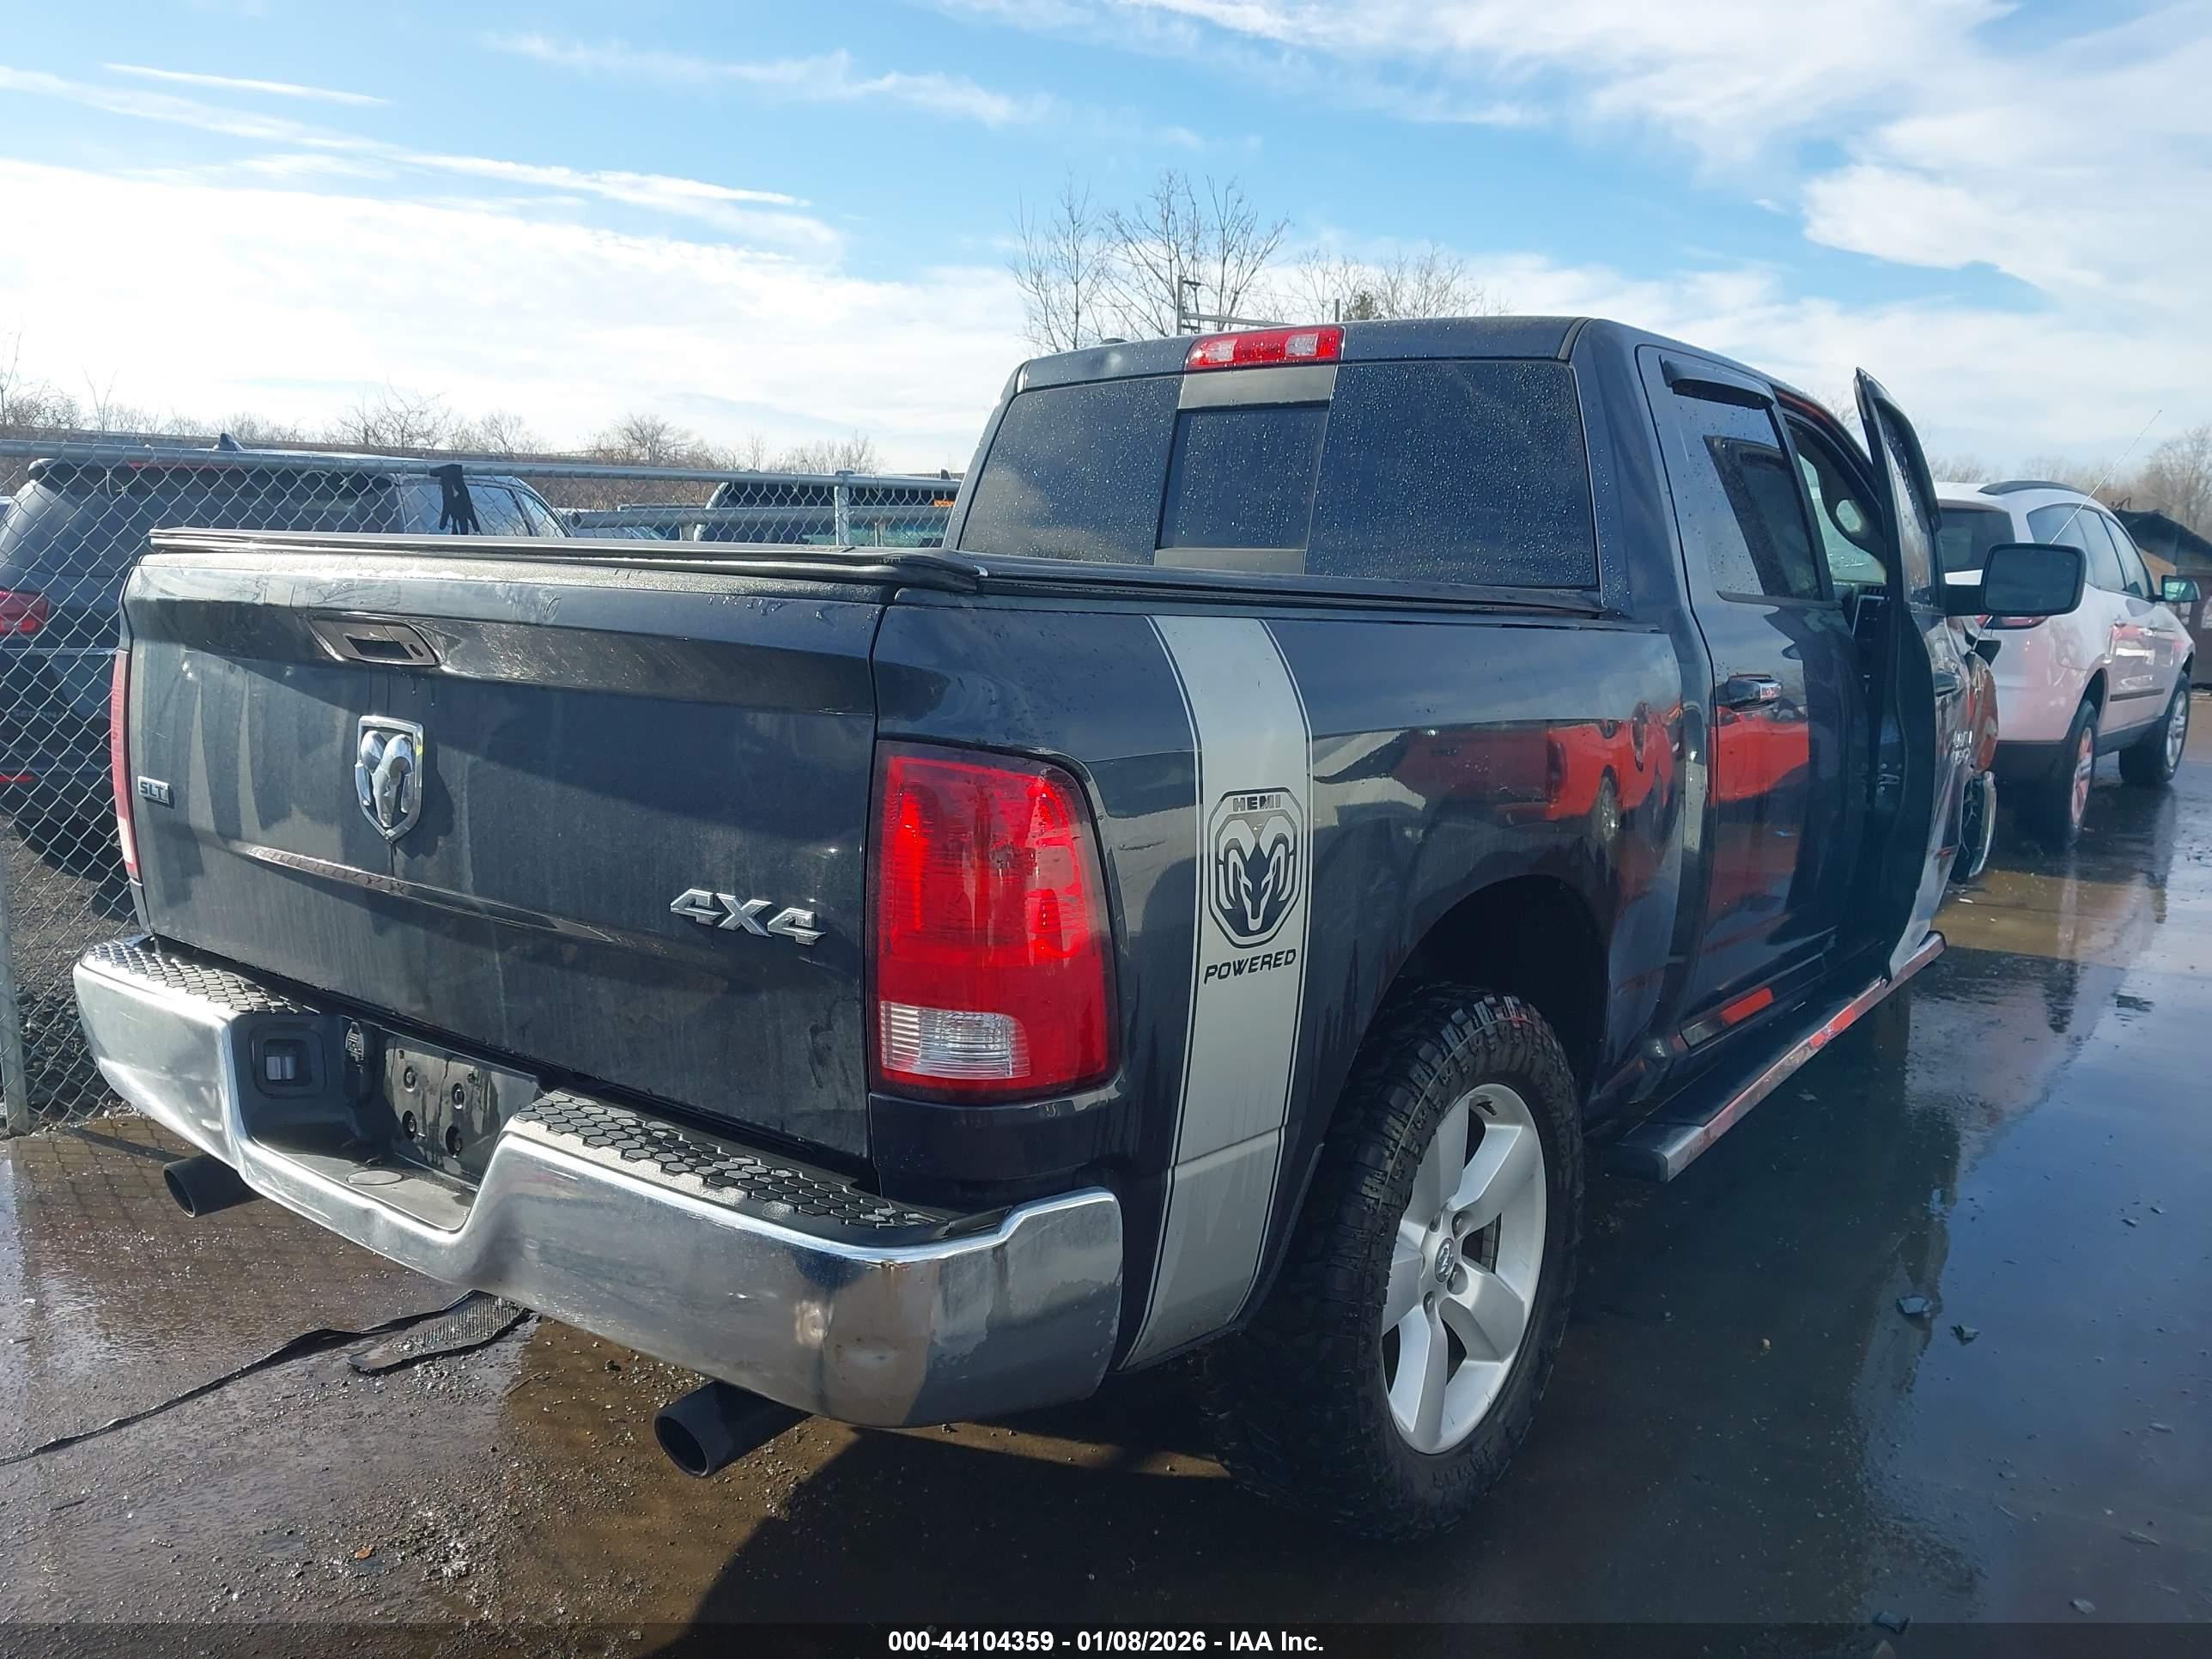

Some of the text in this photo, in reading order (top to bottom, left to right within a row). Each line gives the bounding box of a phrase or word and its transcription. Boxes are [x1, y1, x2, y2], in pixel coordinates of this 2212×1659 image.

[140, 781, 164, 799] SLT
[1232, 793, 1281, 812] HEMI
[1203, 948, 1297, 985] POWERED
